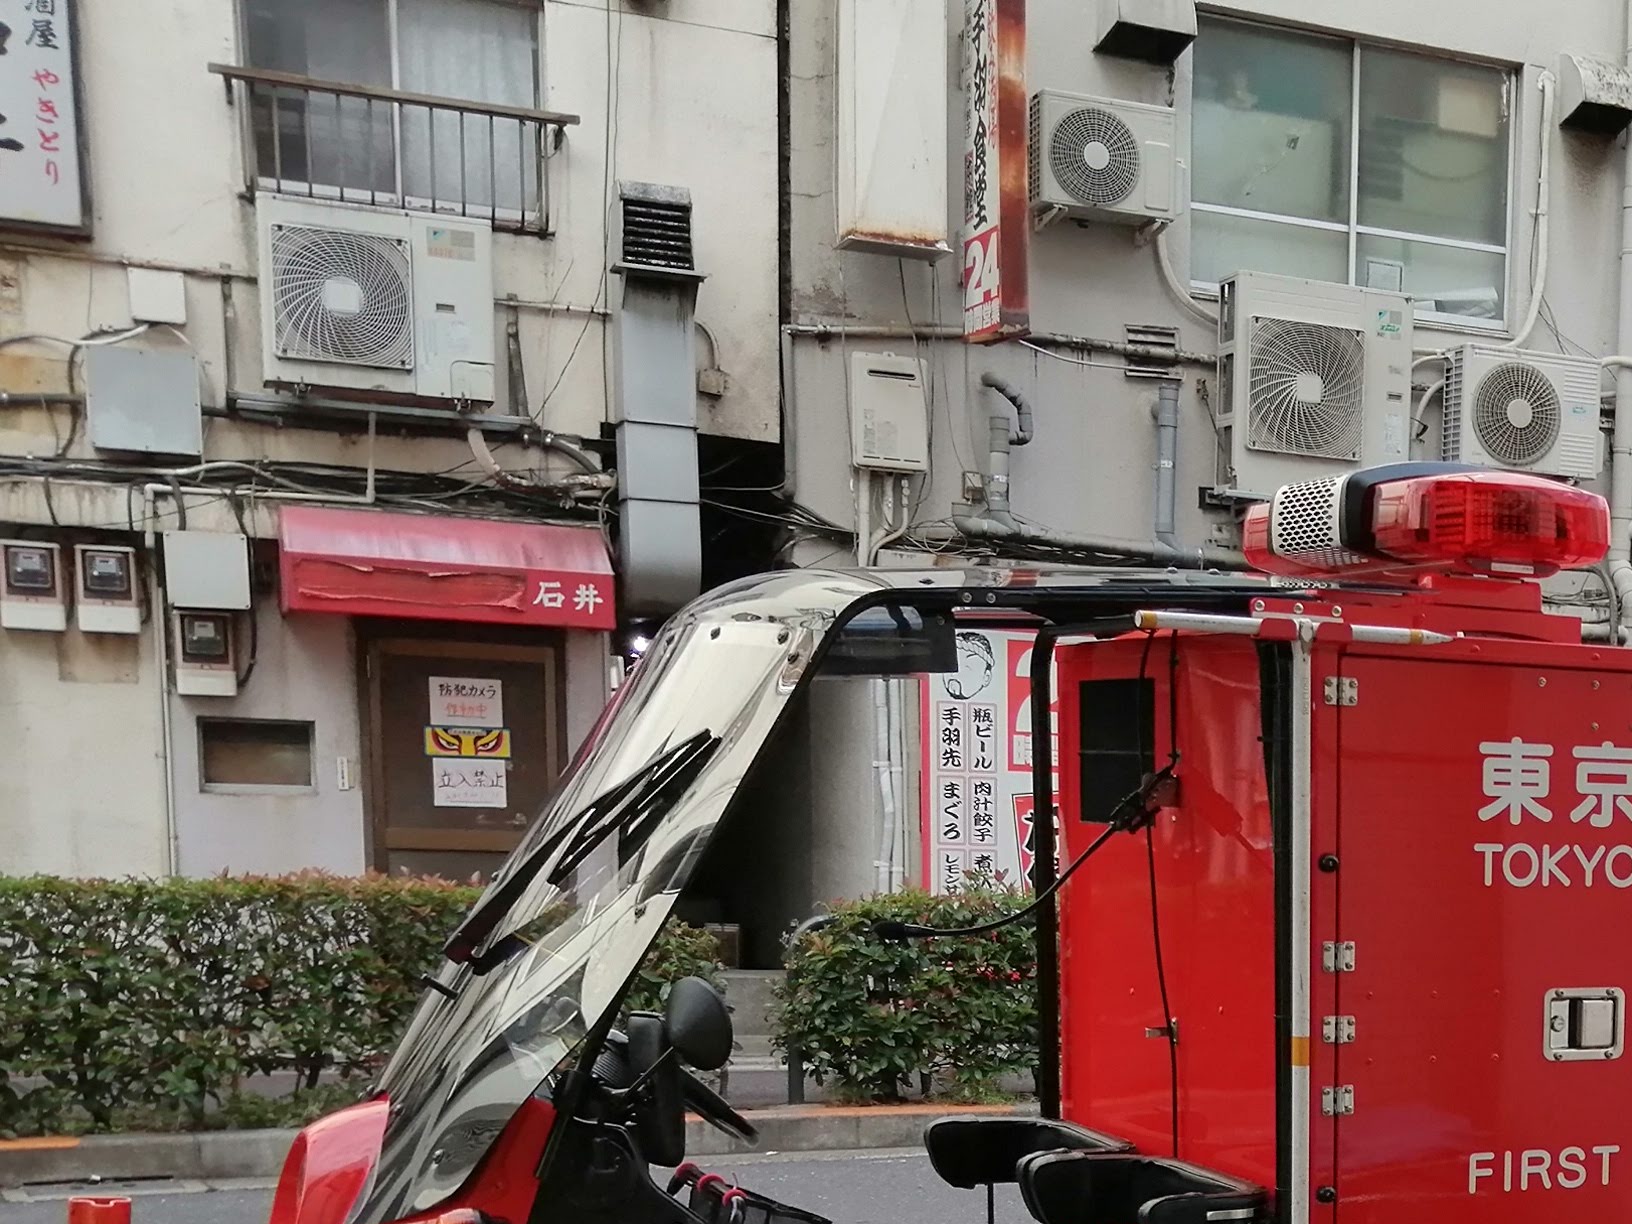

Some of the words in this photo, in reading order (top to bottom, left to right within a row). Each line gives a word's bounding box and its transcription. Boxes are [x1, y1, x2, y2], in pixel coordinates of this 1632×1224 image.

[31, 68, 60, 185] やきとり
[965, 231, 999, 309] 24
[533, 581, 603, 614] 石井
[942, 707, 962, 768] 手羽先
[972, 707, 993, 769] 瓶ビール
[438, 769, 504, 788] 立入禁止
[943, 781, 962, 840] まぐろ
[973, 781, 993, 843] 肉汁餃子
[1468, 1144, 1620, 1195] FIRST
